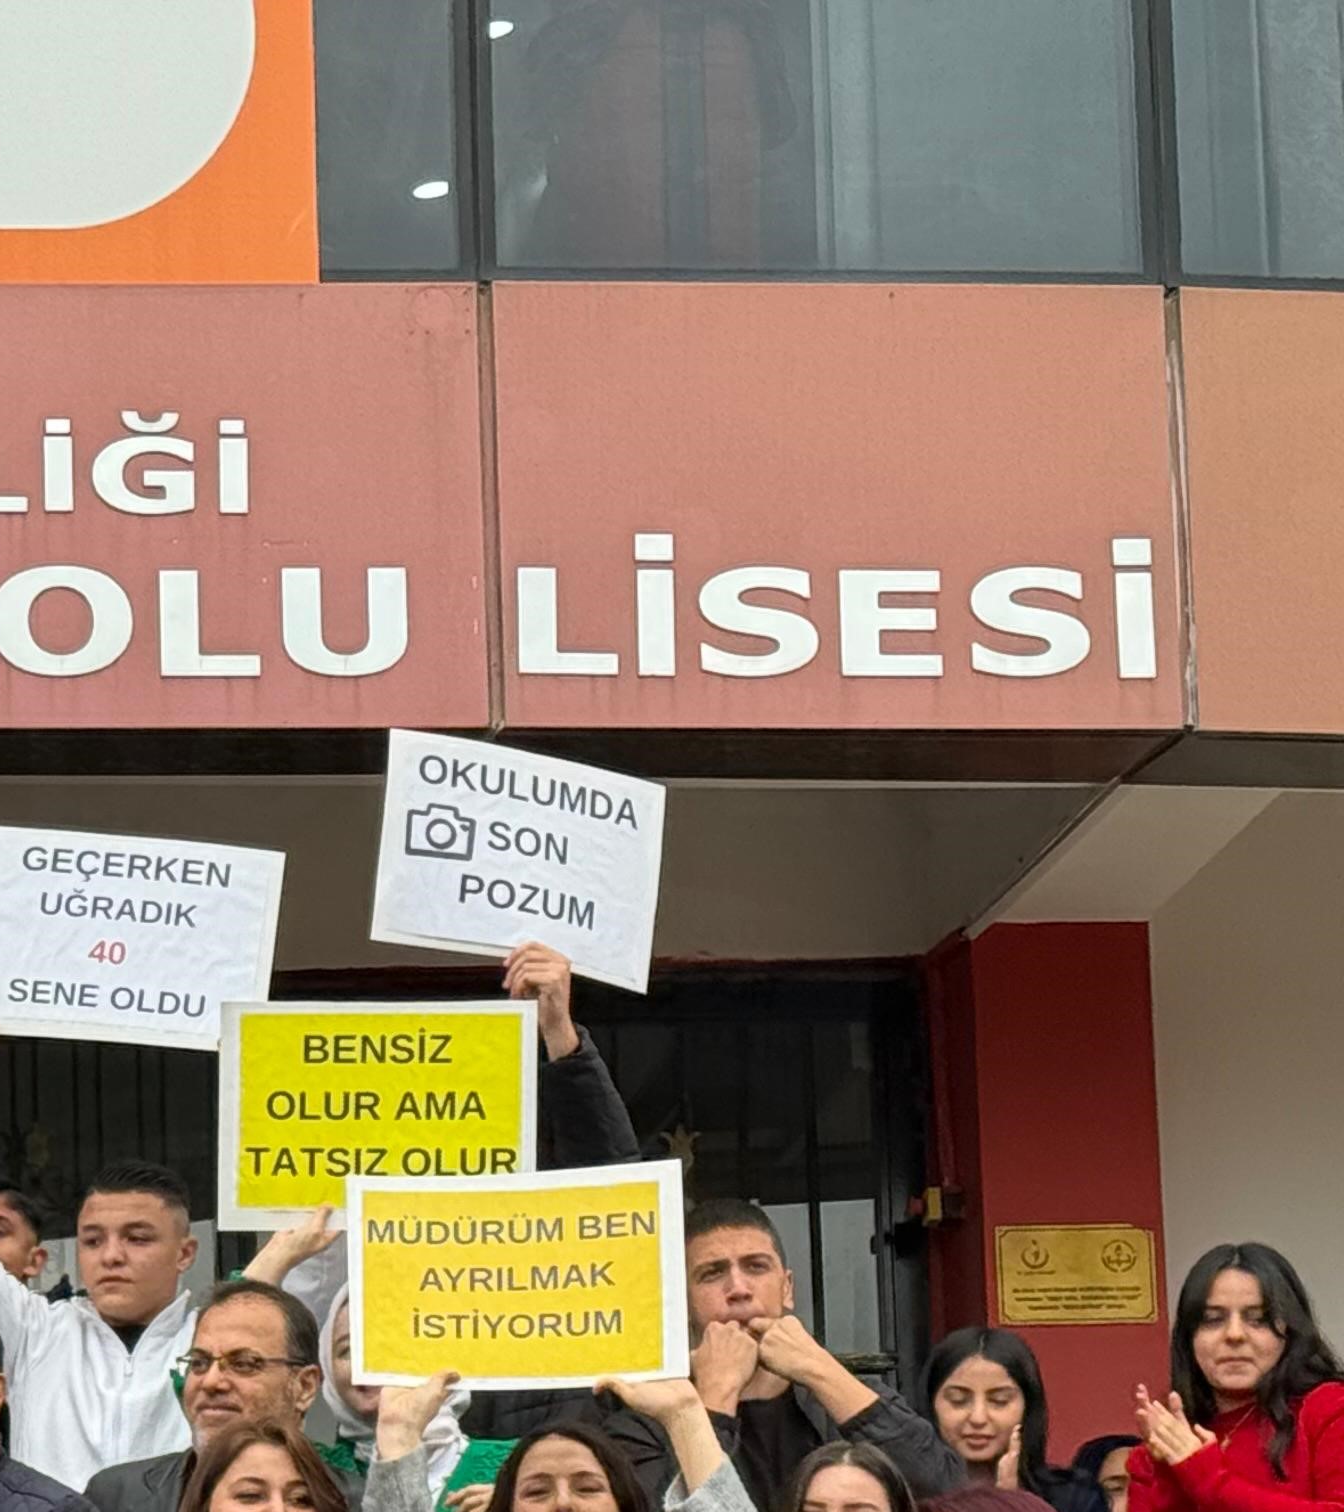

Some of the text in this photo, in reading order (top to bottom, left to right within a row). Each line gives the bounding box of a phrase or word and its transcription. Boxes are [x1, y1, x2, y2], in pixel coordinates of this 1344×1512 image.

[517, 533, 1157, 679] LİSESİ
[418, 755, 639, 830] OKULUMDA
[487, 821, 569, 865] SON
[22, 846, 232, 888] GEÇERKEN
[40, 888, 198, 929] UĞRADIK
[458, 873, 596, 930] POZUM
[87, 940, 127, 966] 40
[7, 978, 206, 1018] SENE OLDU
[303, 1028, 453, 1064] BENSİZ
[266, 1091, 487, 1121] OLUR AMA
[245, 1146, 518, 1178] TATSIZ OLUR
[367, 1211, 656, 1246] MÜDÜRÜM BEN
[419, 1260, 616, 1293] AYRILMAK
[412, 1308, 623, 1340] İSTİYORUM
